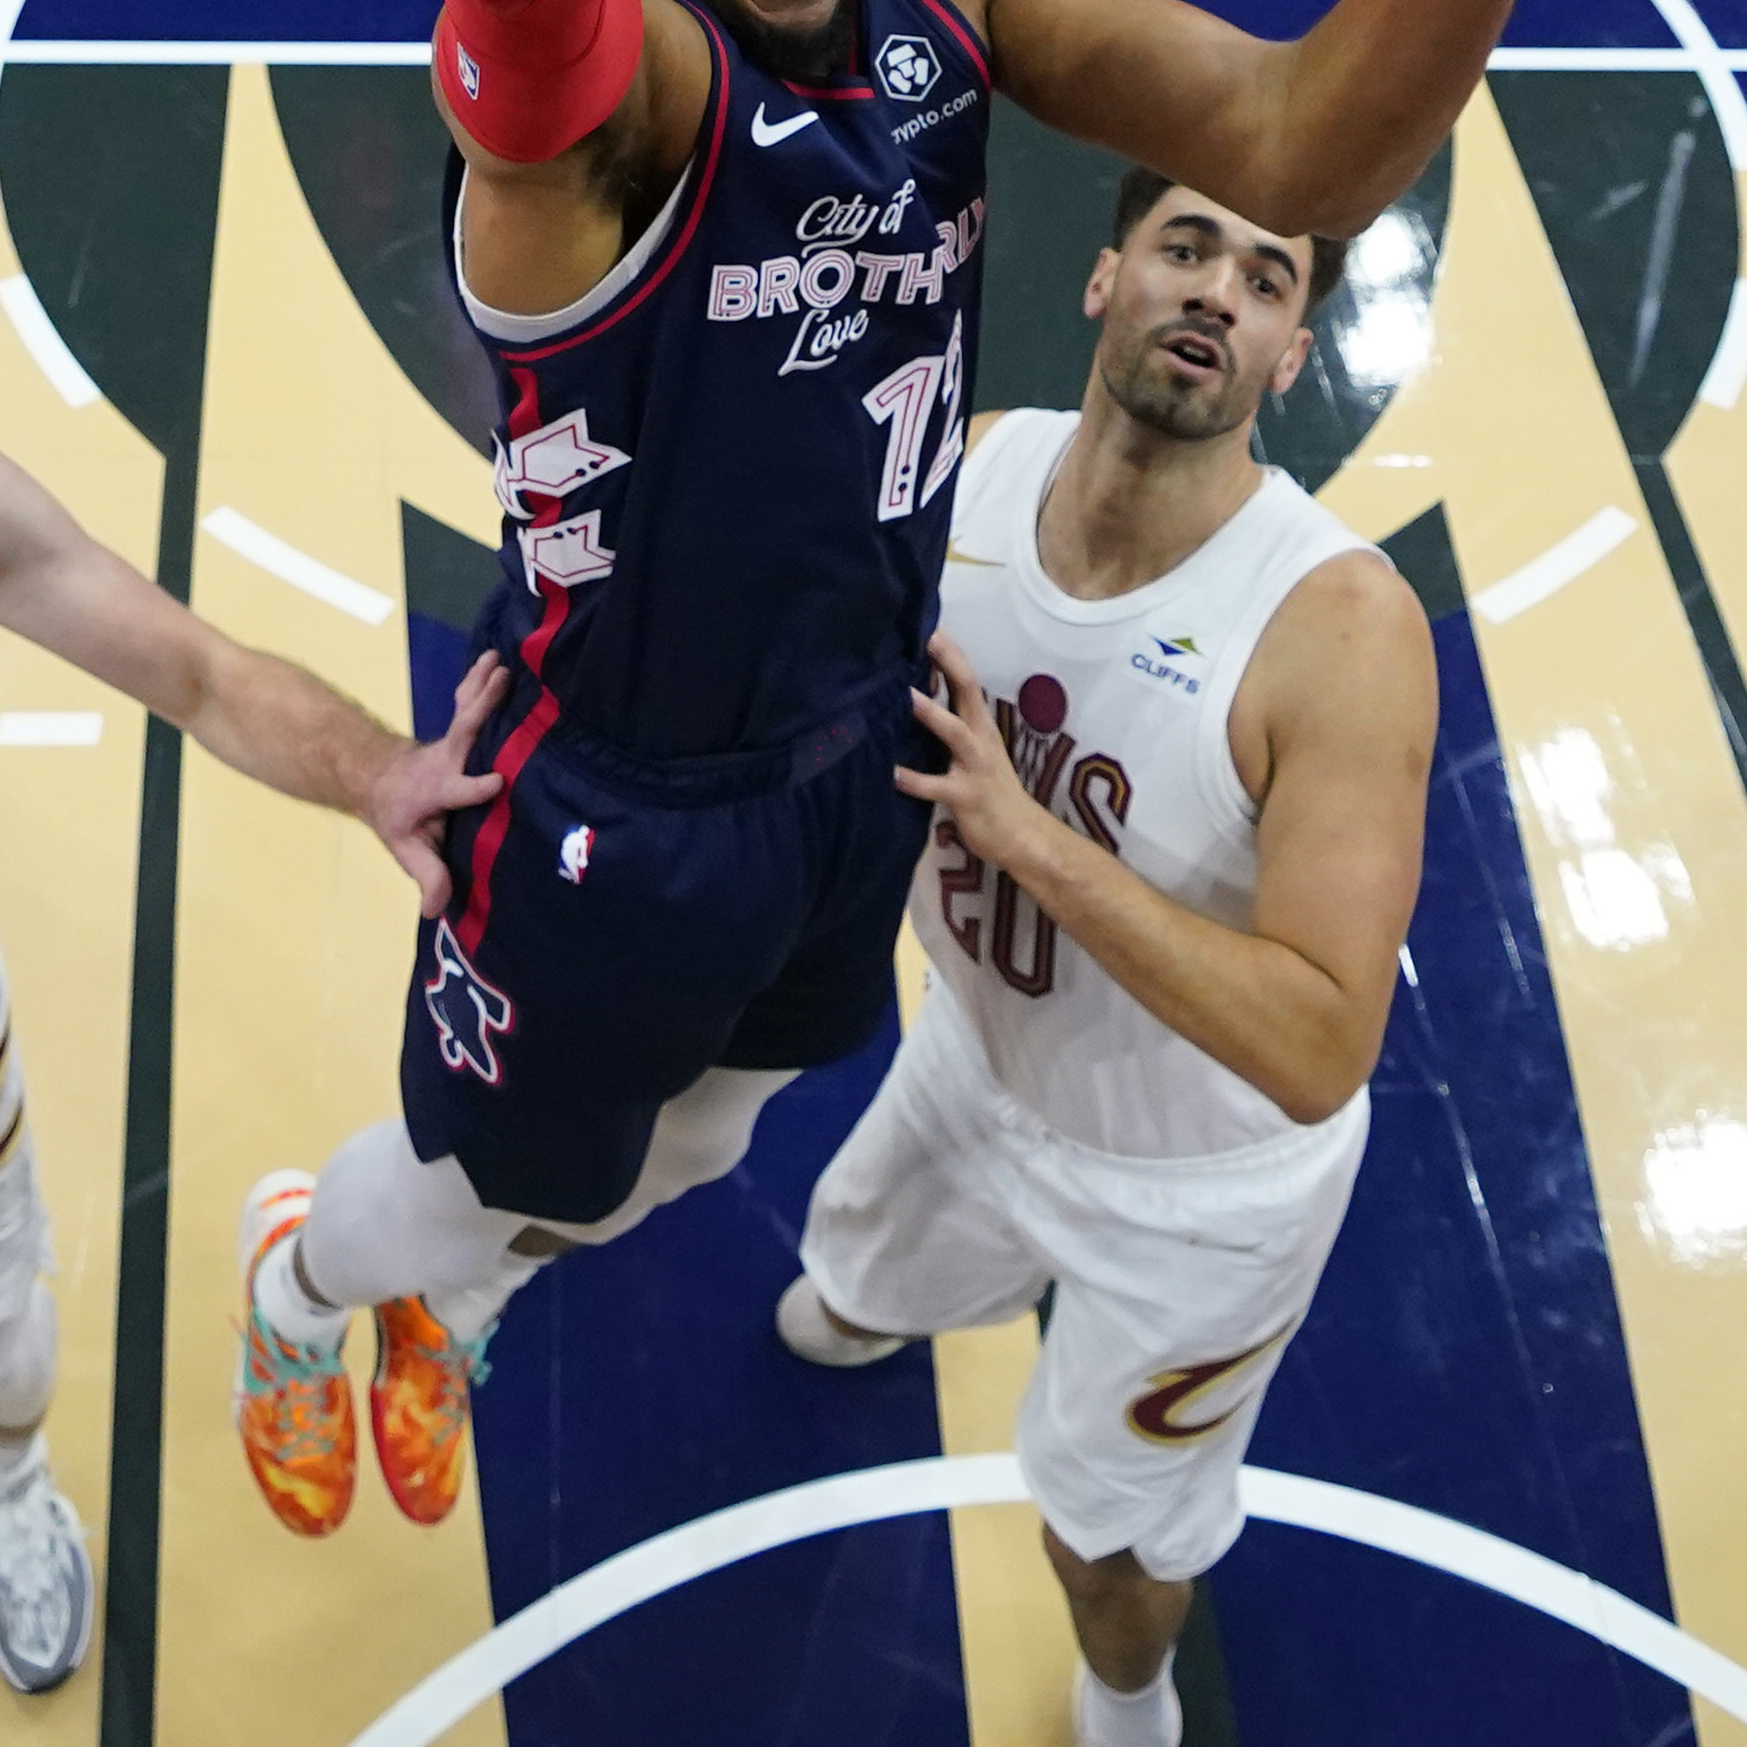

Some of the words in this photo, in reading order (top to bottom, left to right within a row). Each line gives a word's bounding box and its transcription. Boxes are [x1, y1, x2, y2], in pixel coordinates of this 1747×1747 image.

[795, 193, 881, 258] City
[878, 178, 917, 236] of
[777, 308, 870, 377] Love
[861, 307, 965, 523] 12
[1130, 653, 1201, 696] CLIFFS
[935, 819, 1057, 999] 20
